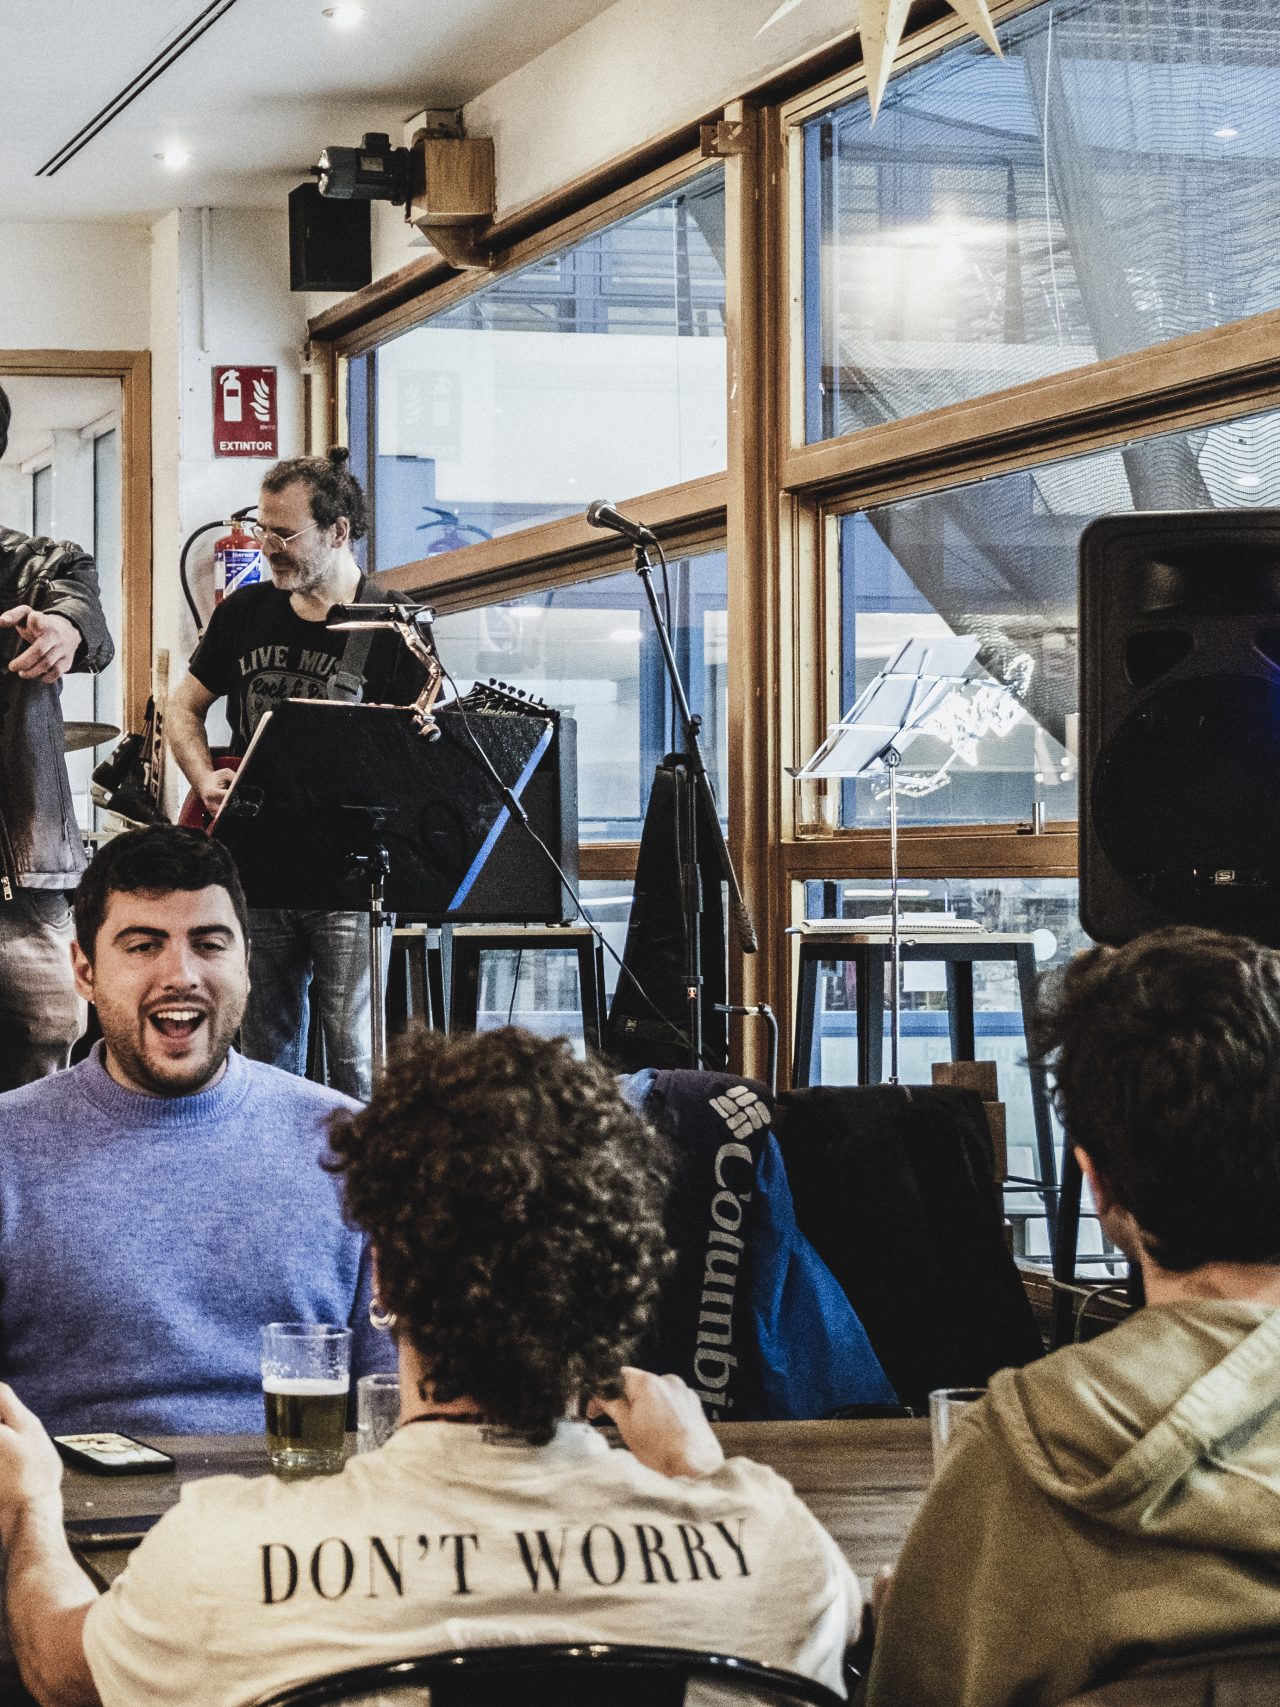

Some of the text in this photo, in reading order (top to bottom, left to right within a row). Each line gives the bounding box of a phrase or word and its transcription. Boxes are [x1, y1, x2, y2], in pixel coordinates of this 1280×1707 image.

[219, 440, 273, 451] EXTINTOR
[238, 645, 338, 677] LIVE MU
[690, 1142, 753, 1420] Columbi
[259, 1517, 753, 1606] DON'T WORRY
